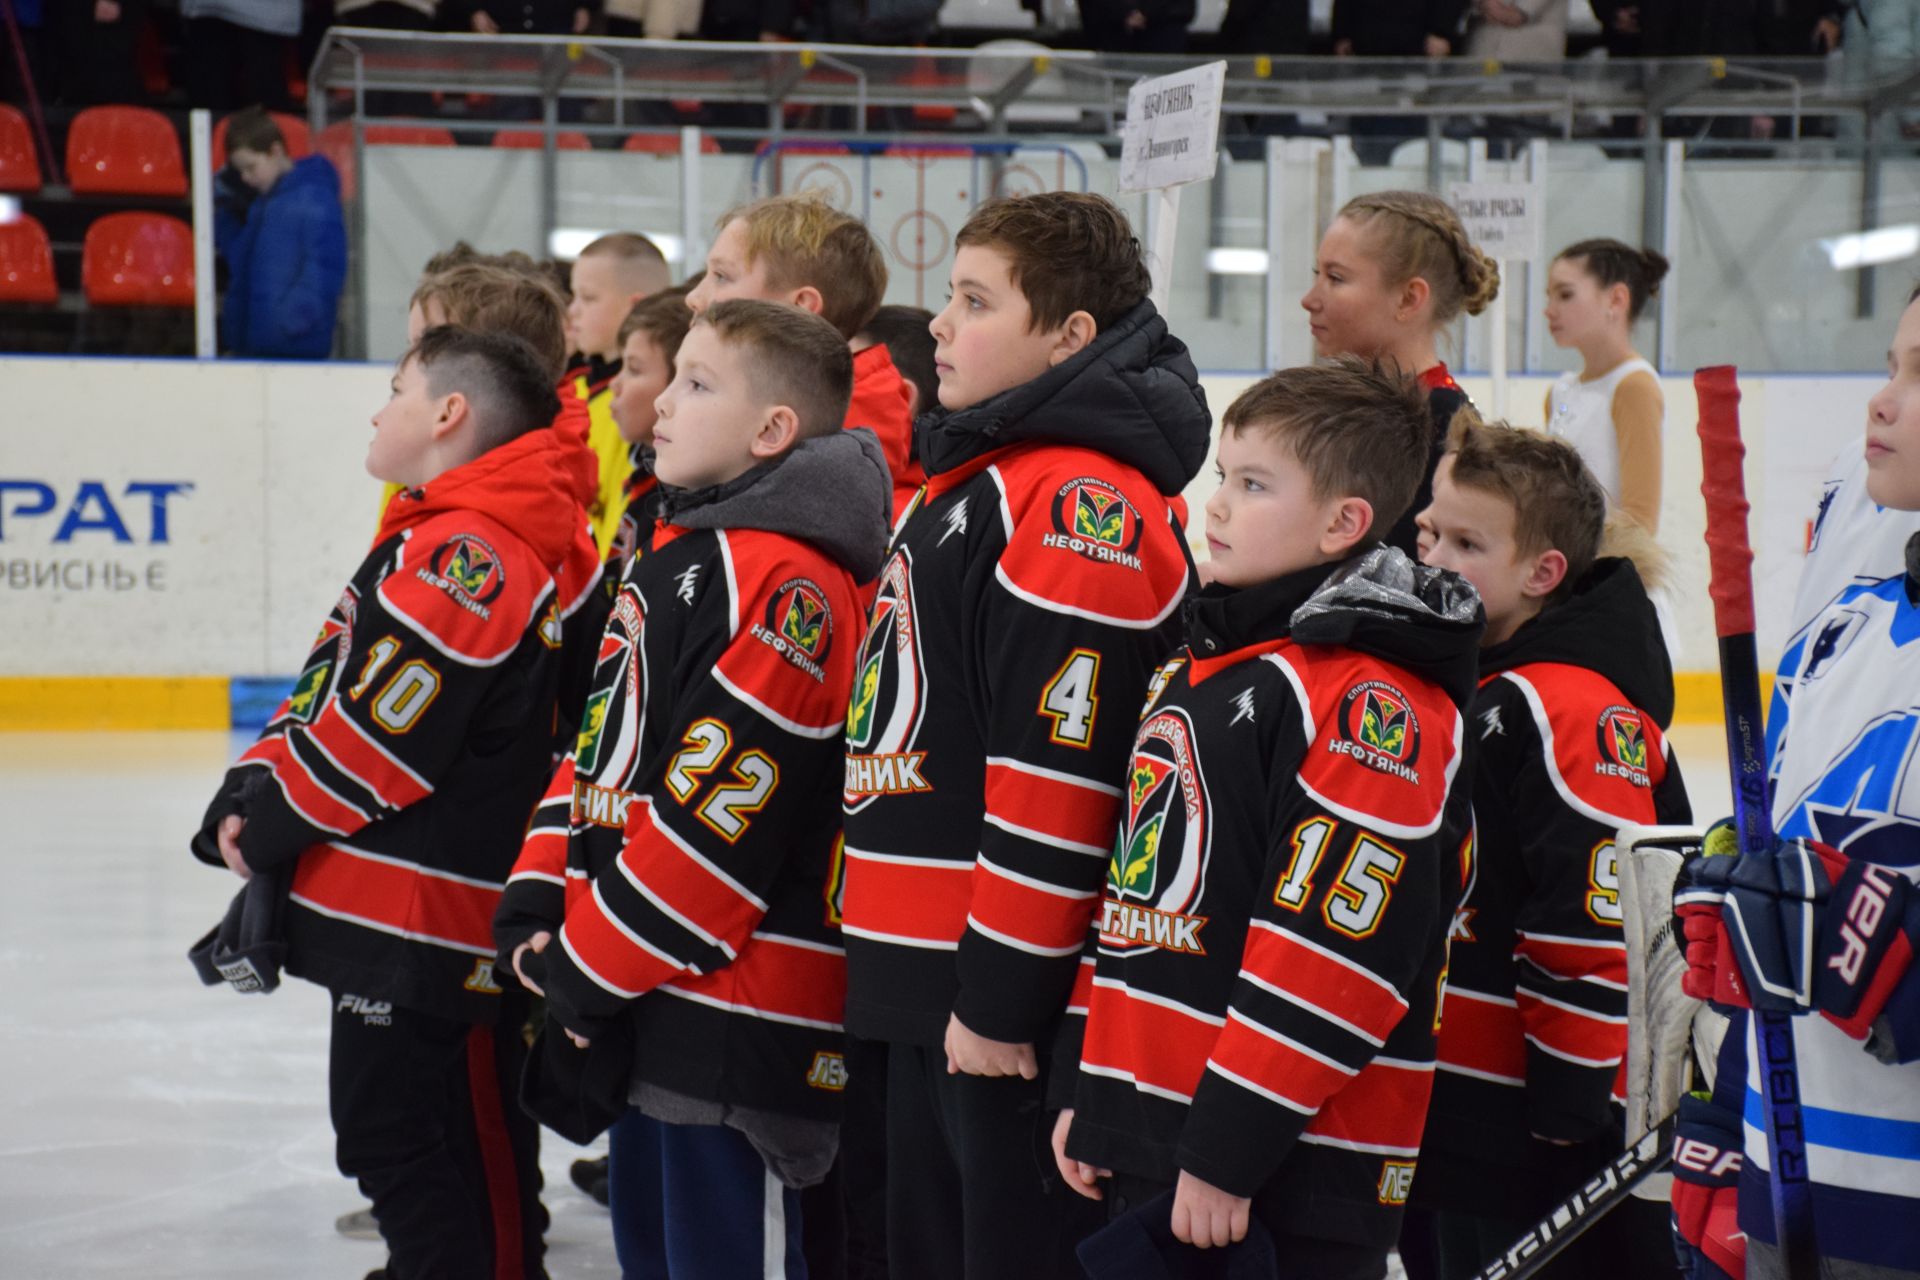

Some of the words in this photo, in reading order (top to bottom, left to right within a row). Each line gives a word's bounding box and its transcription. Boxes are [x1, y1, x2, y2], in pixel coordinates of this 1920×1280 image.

[1042, 533, 1142, 572] НЕФТЯНИК
[416, 567, 490, 621] НЕФТЯНИК
[750, 623, 825, 684] НЕФТЯНИК
[350, 635, 441, 735] 10
[1037, 647, 1102, 750] 4
[1347, 681, 1402, 700] СПОРТИВНАЯ
[665, 717, 780, 845] 22
[1328, 739, 1419, 785] НЕФТЯНИК
[1274, 815, 1407, 941] 15
[337, 993, 392, 1015] FILA
[364, 1015, 392, 1027] PRO
